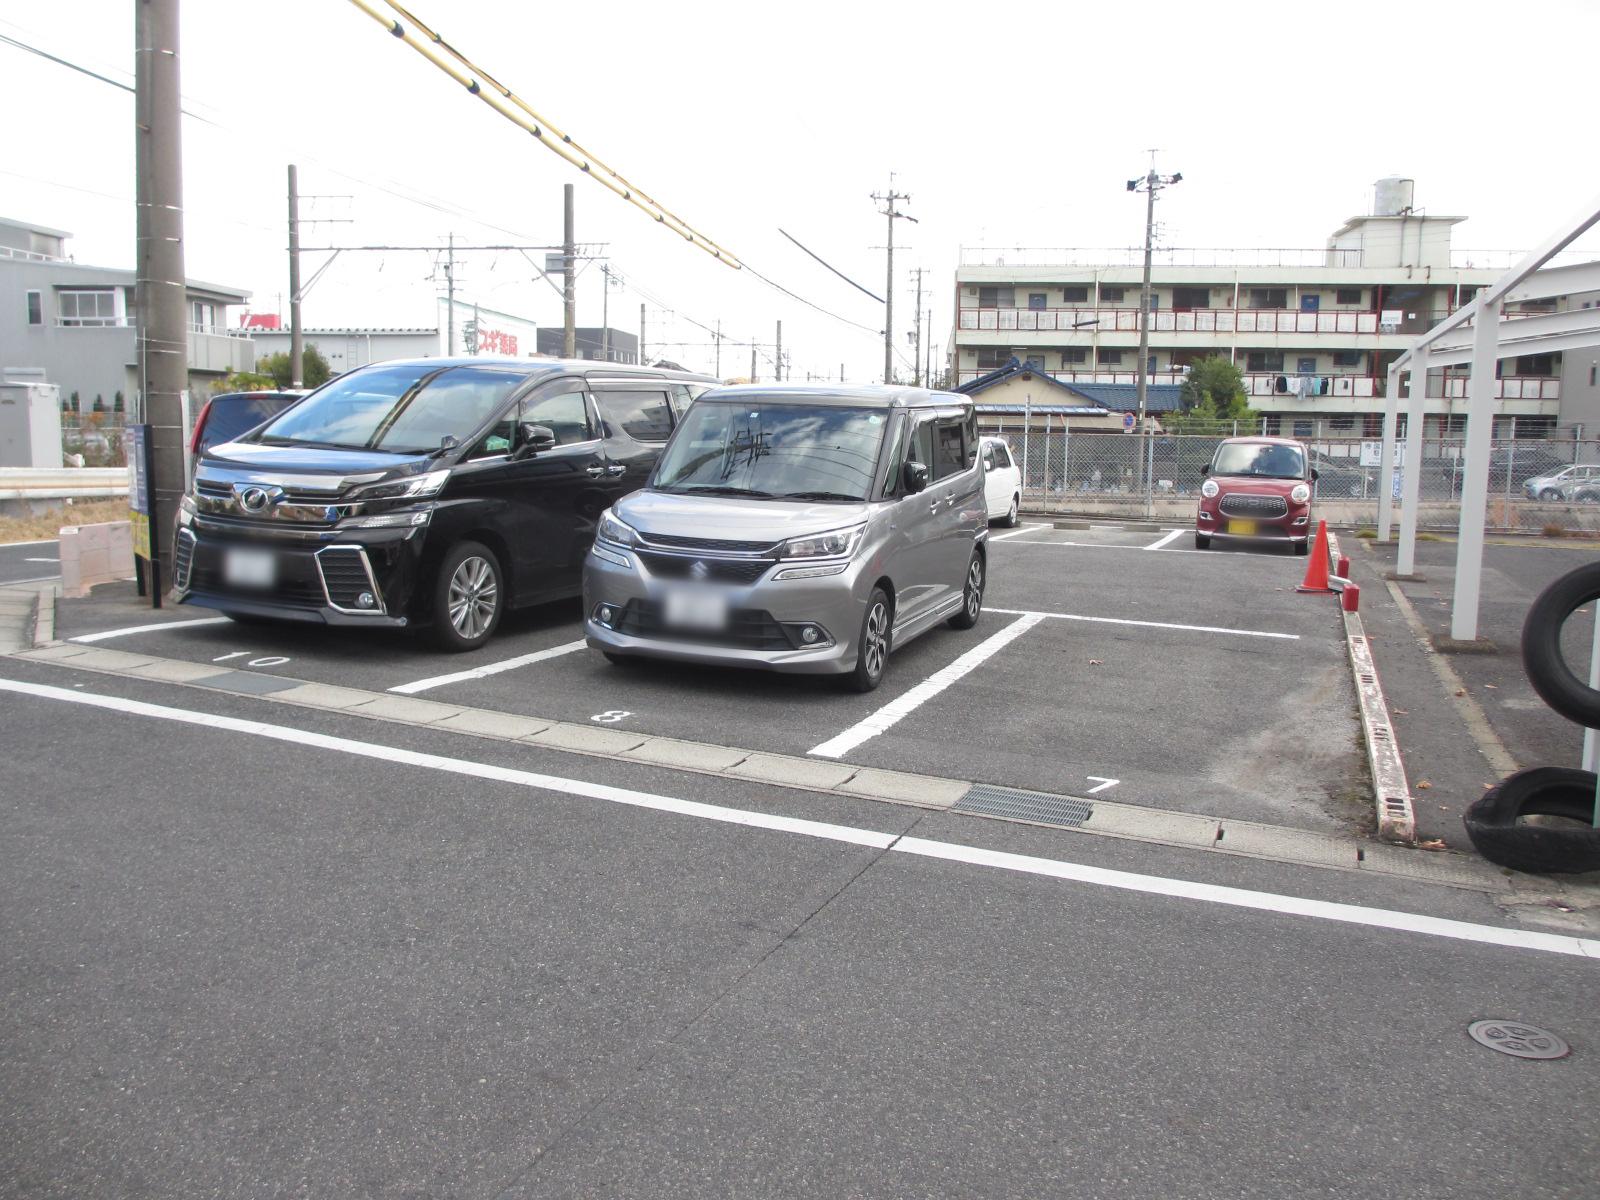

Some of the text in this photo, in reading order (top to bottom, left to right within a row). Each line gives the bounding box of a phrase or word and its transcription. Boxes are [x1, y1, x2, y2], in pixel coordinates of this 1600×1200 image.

[212, 651, 290, 666] 10
[590, 710, 632, 722] 8
[1086, 776, 1120, 793] 7
